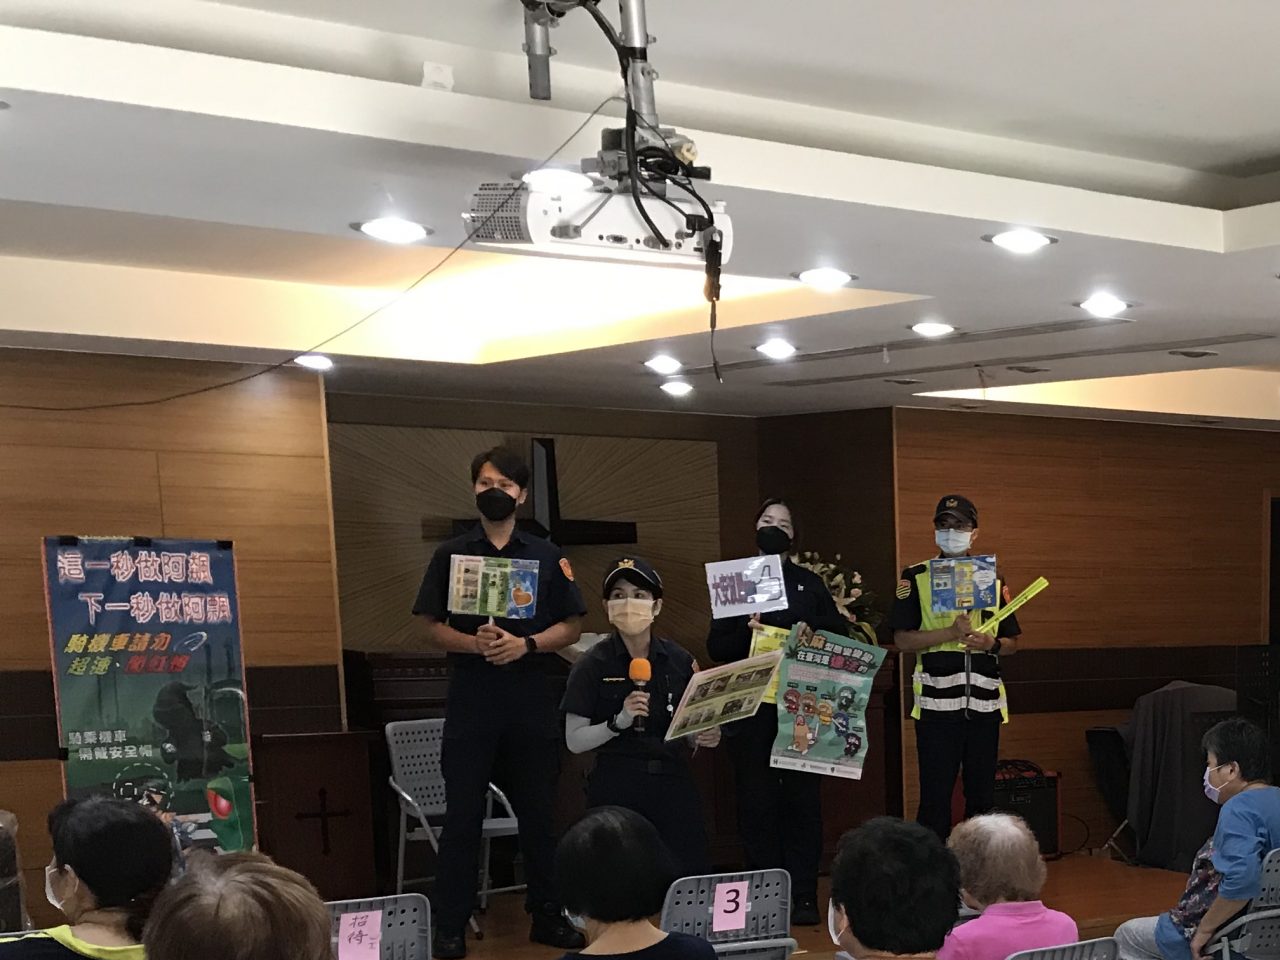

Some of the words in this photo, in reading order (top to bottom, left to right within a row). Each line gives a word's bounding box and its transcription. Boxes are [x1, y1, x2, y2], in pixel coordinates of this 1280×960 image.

[57, 550, 214, 585] 這一秒做阿飆
[78, 592, 232, 625] 下一秒做阿飄
[723, 888, 740, 914] 3
